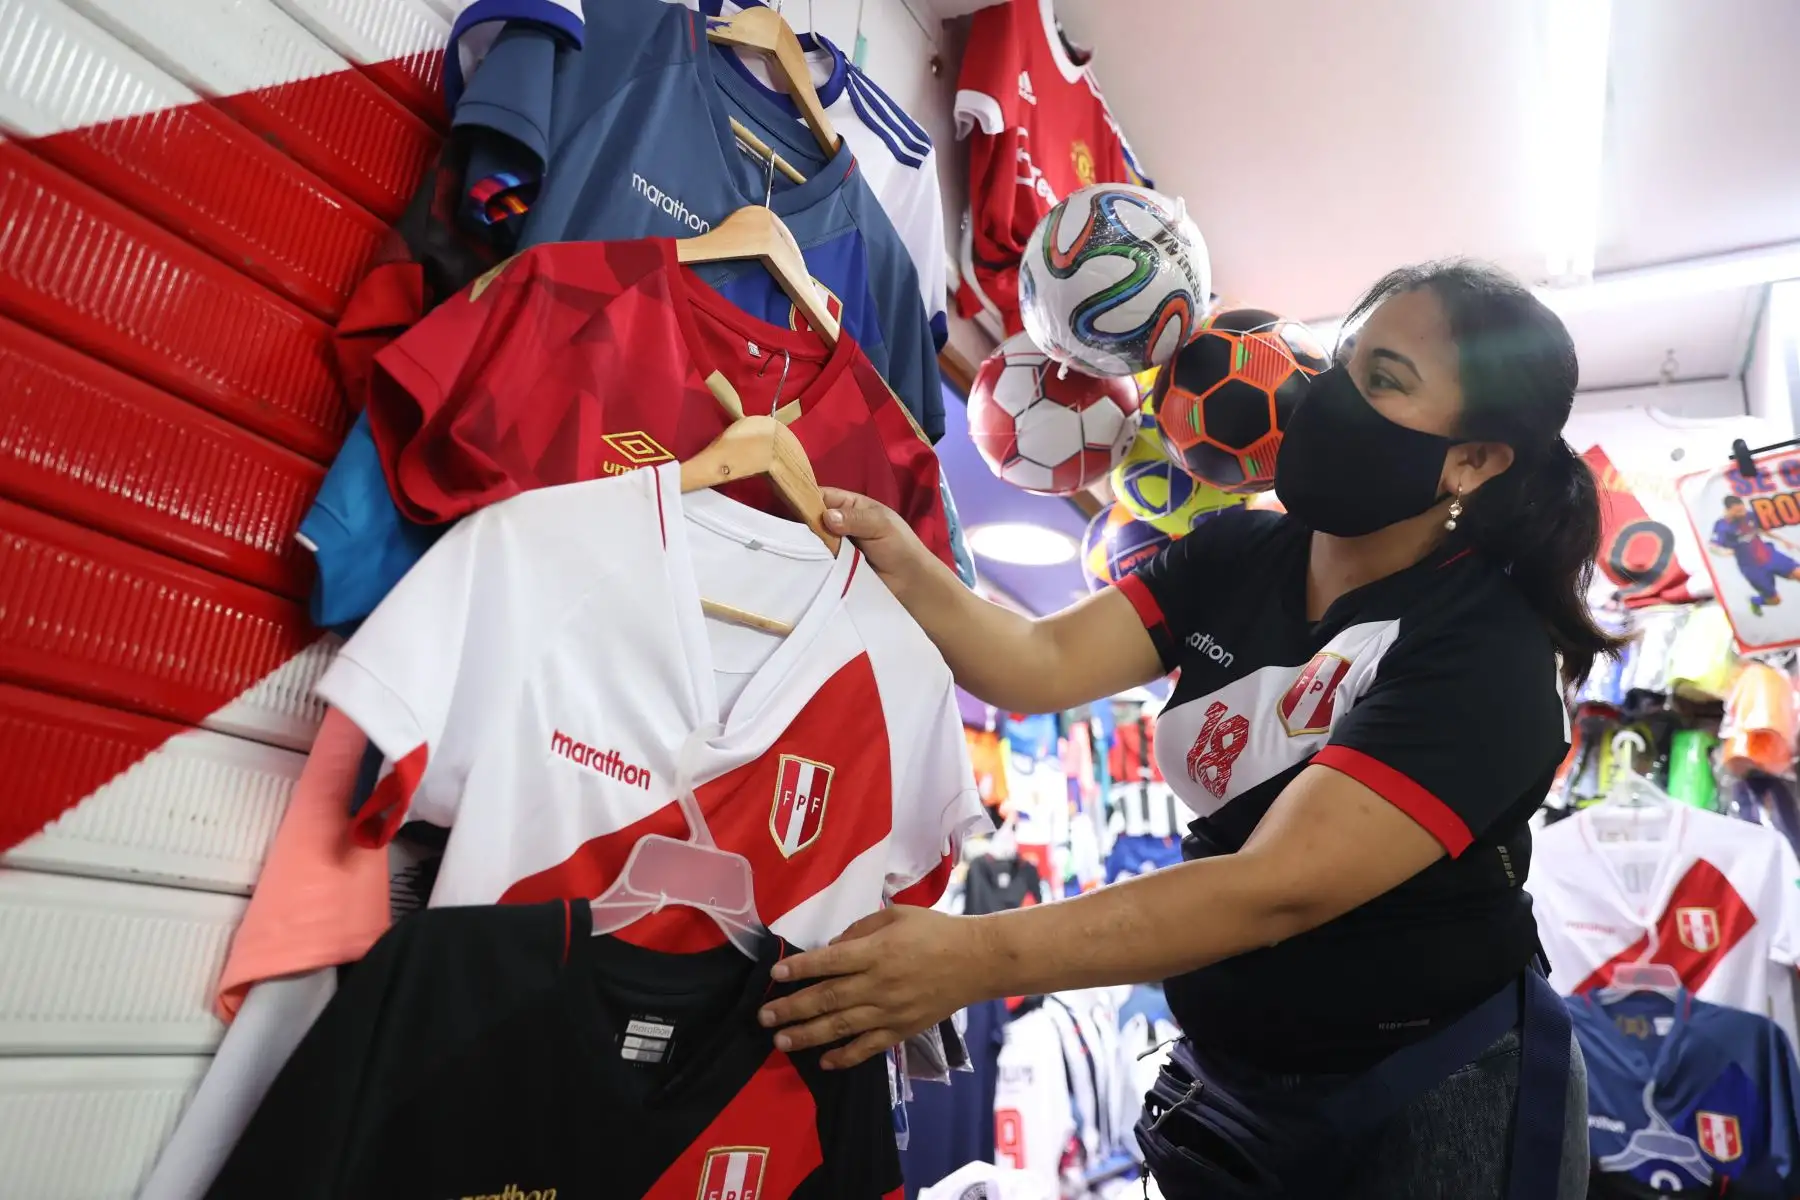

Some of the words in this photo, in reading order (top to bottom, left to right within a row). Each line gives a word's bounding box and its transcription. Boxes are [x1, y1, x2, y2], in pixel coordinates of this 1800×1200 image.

[632, 172, 710, 233] marathon
[1751, 491, 1800, 531] RO
[551, 729, 651, 791] marathon
[1186, 700, 1250, 800] 18
[782, 790, 821, 814] FPF
